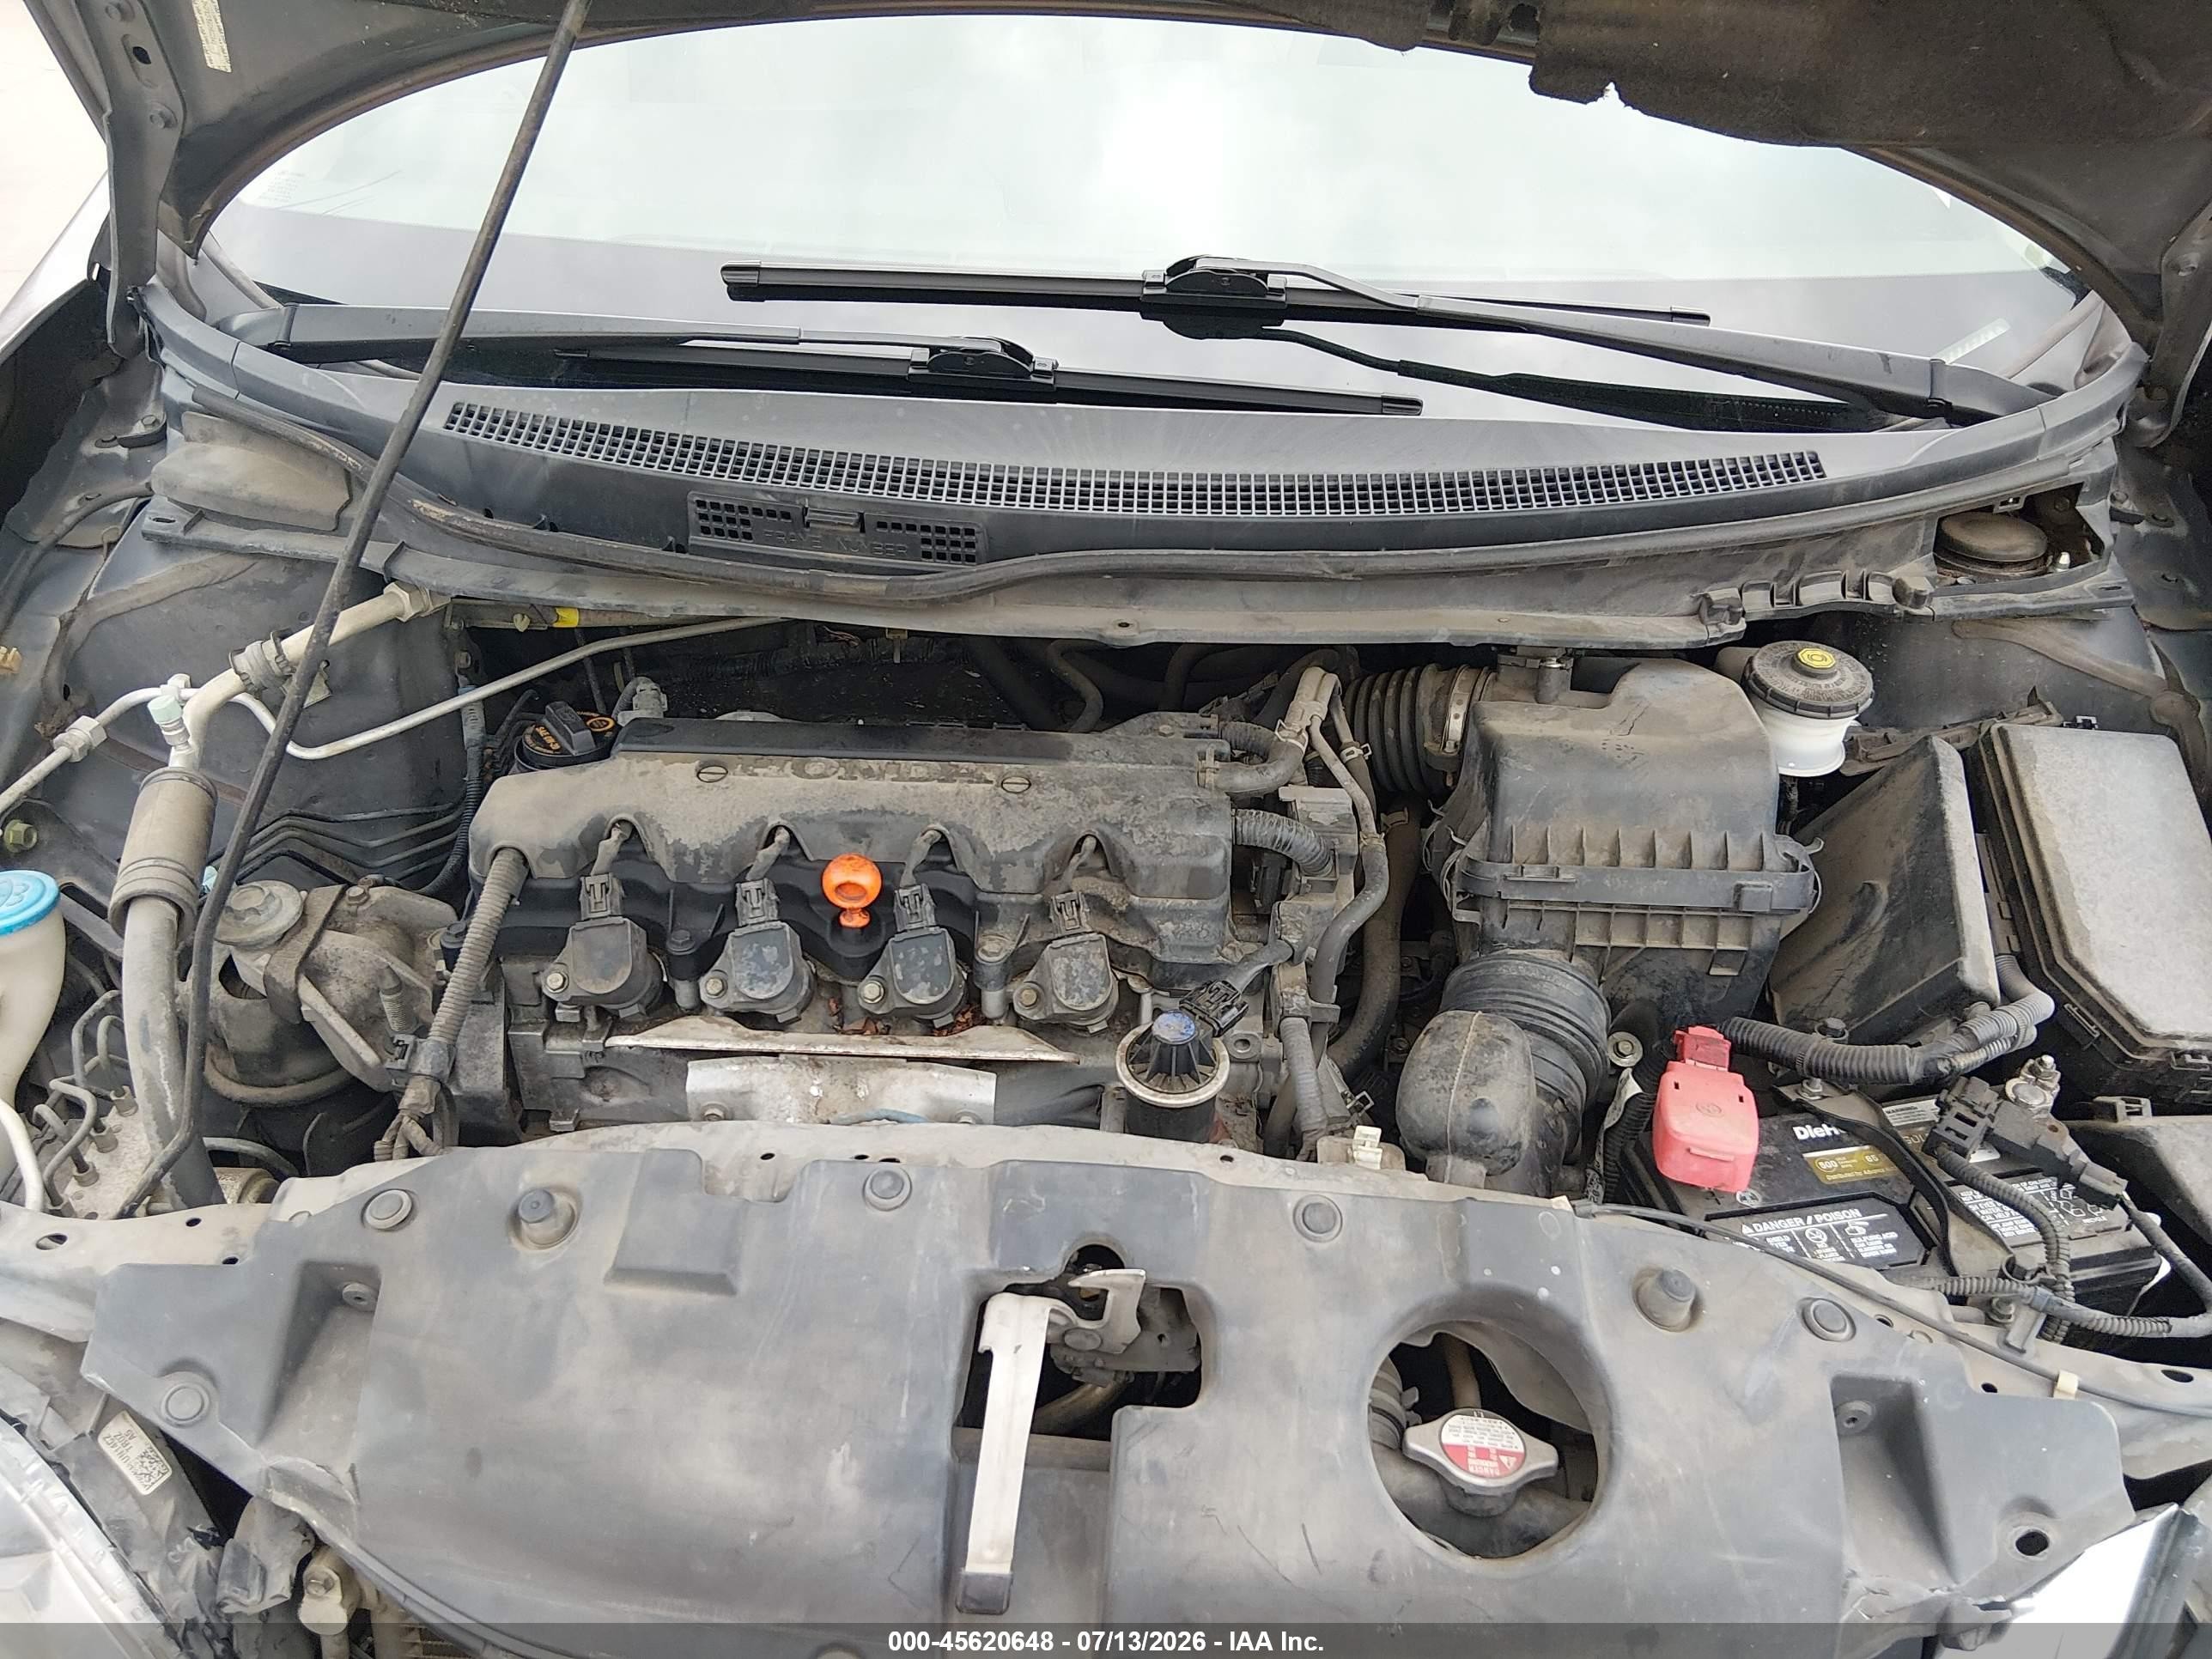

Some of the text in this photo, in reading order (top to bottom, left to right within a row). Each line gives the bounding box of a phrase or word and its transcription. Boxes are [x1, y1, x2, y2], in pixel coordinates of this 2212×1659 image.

[763, 530, 908, 556] FRAME NUMBER
[1792, 1123, 1846, 1140] DieH
[1752, 1216, 1804, 1233] DANGER
[1814, 1208, 1863, 1224] POISON
